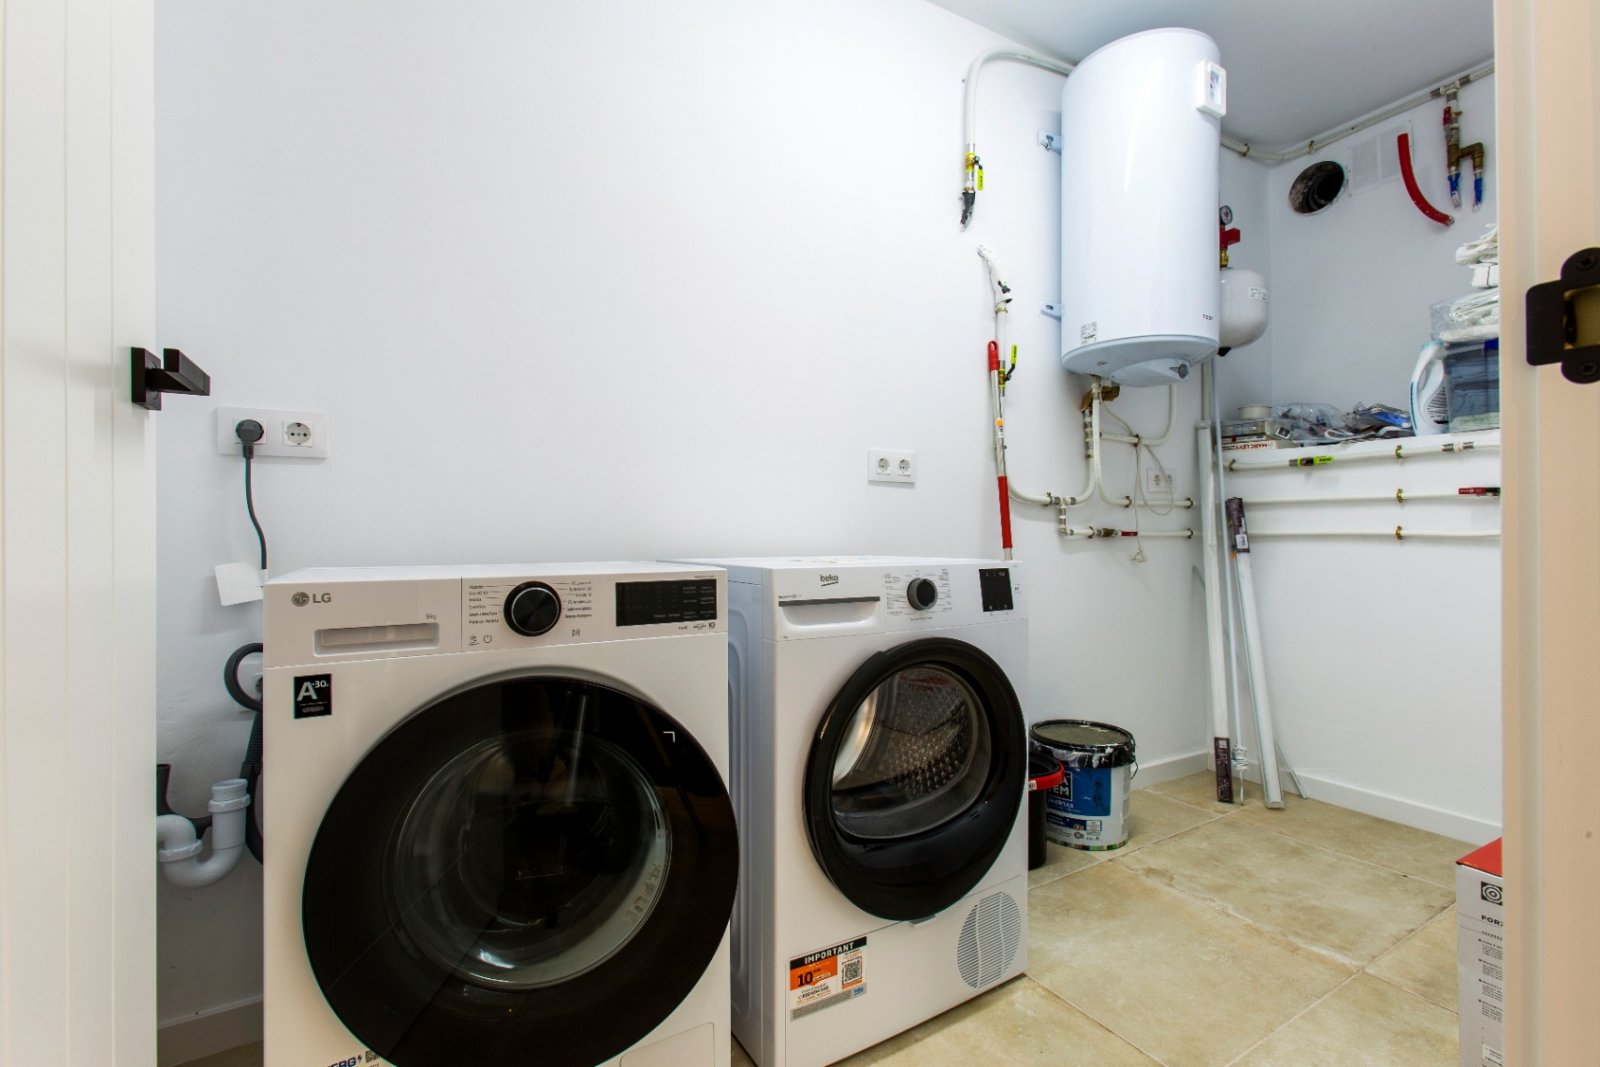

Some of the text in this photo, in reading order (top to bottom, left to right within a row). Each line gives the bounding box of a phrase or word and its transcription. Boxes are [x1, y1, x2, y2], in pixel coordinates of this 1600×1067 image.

[820, 574, 839, 582] beko
[312, 592, 331, 603] LG
[804, 942, 854, 964] IMPORTANT
[798, 972, 813, 987] 10
